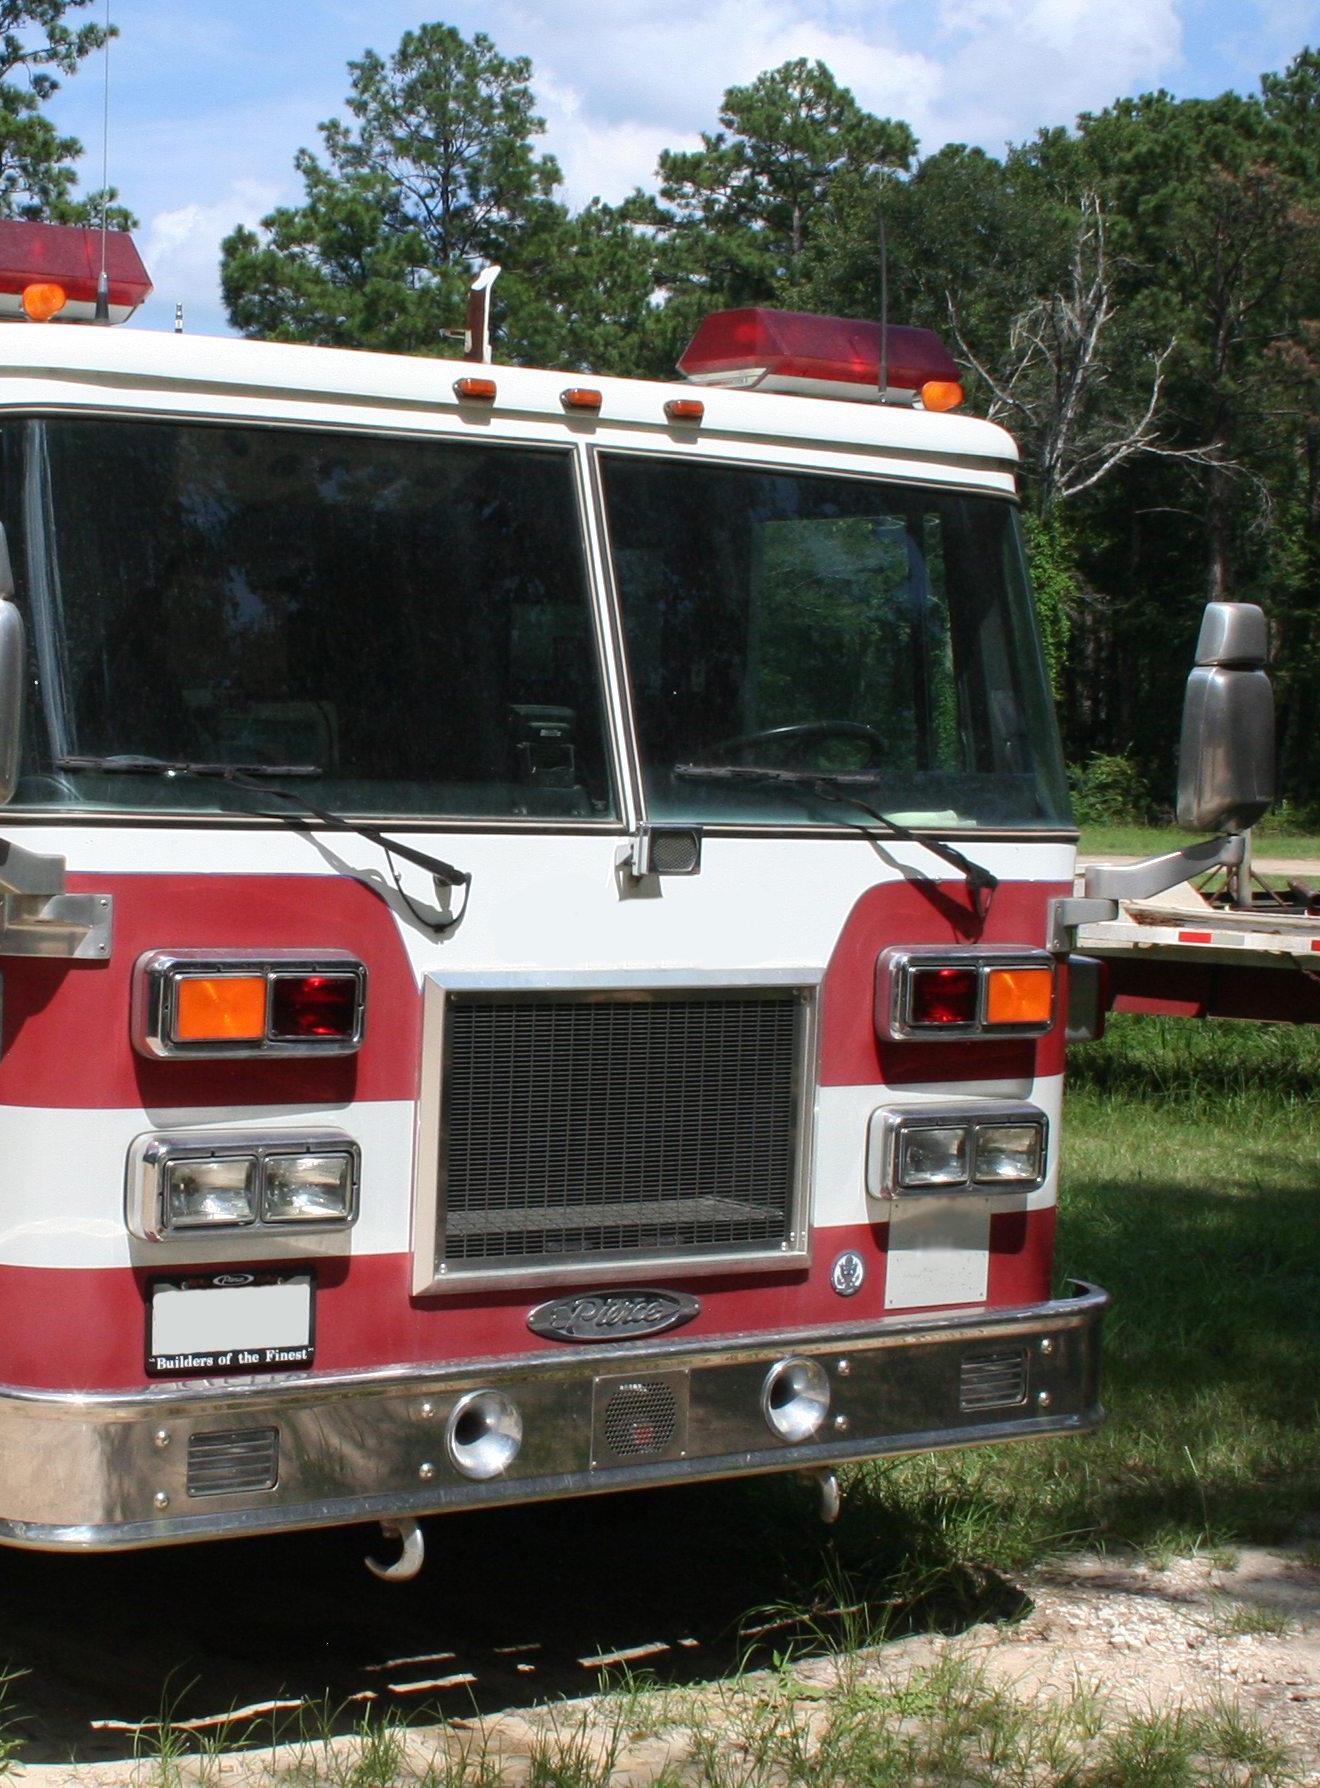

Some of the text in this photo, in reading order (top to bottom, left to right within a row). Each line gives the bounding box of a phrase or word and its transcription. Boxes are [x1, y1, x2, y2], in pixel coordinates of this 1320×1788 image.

[565, 1297, 664, 1335] Pierce
[218, 1352, 233, 1366] of
[238, 1351, 260, 1365] the
